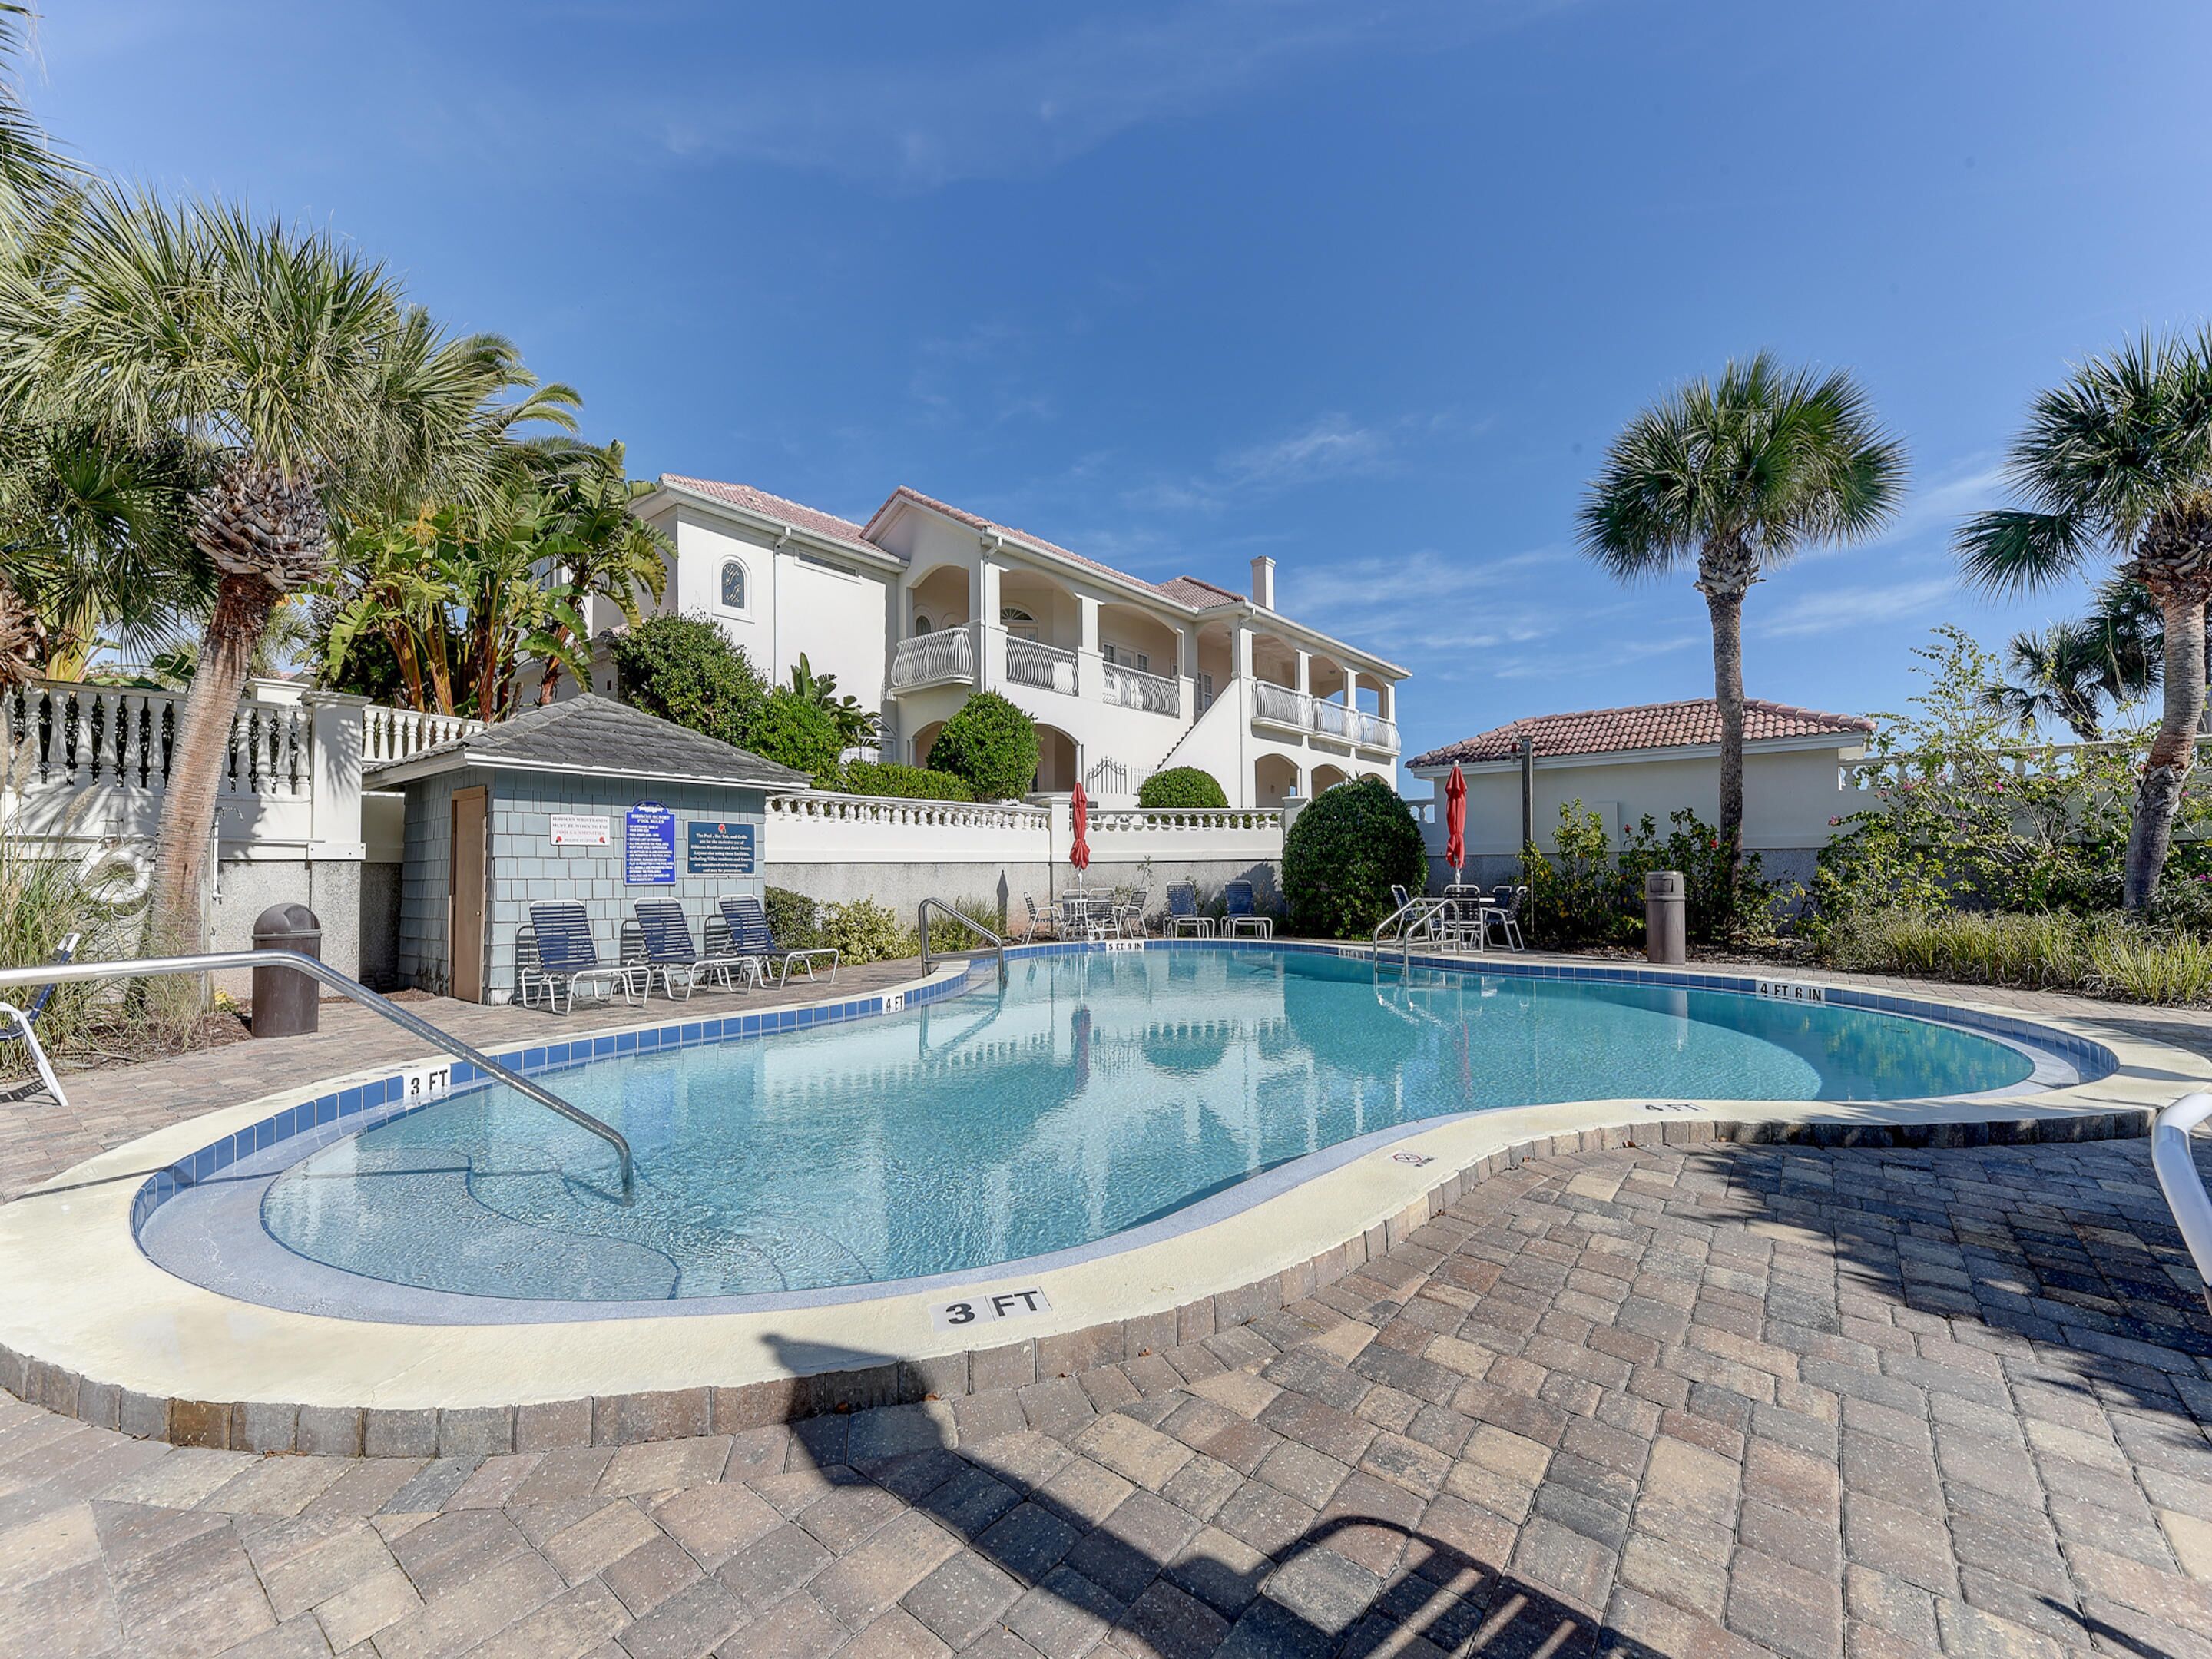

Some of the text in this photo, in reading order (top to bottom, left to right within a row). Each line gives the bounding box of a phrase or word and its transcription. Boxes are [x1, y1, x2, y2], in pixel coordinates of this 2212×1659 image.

[1760, 983, 1821, 1001] 4 FT 6 IN
[411, 1068, 449, 1095] 3 FT
[945, 1290, 1038, 1325] 3 FT
